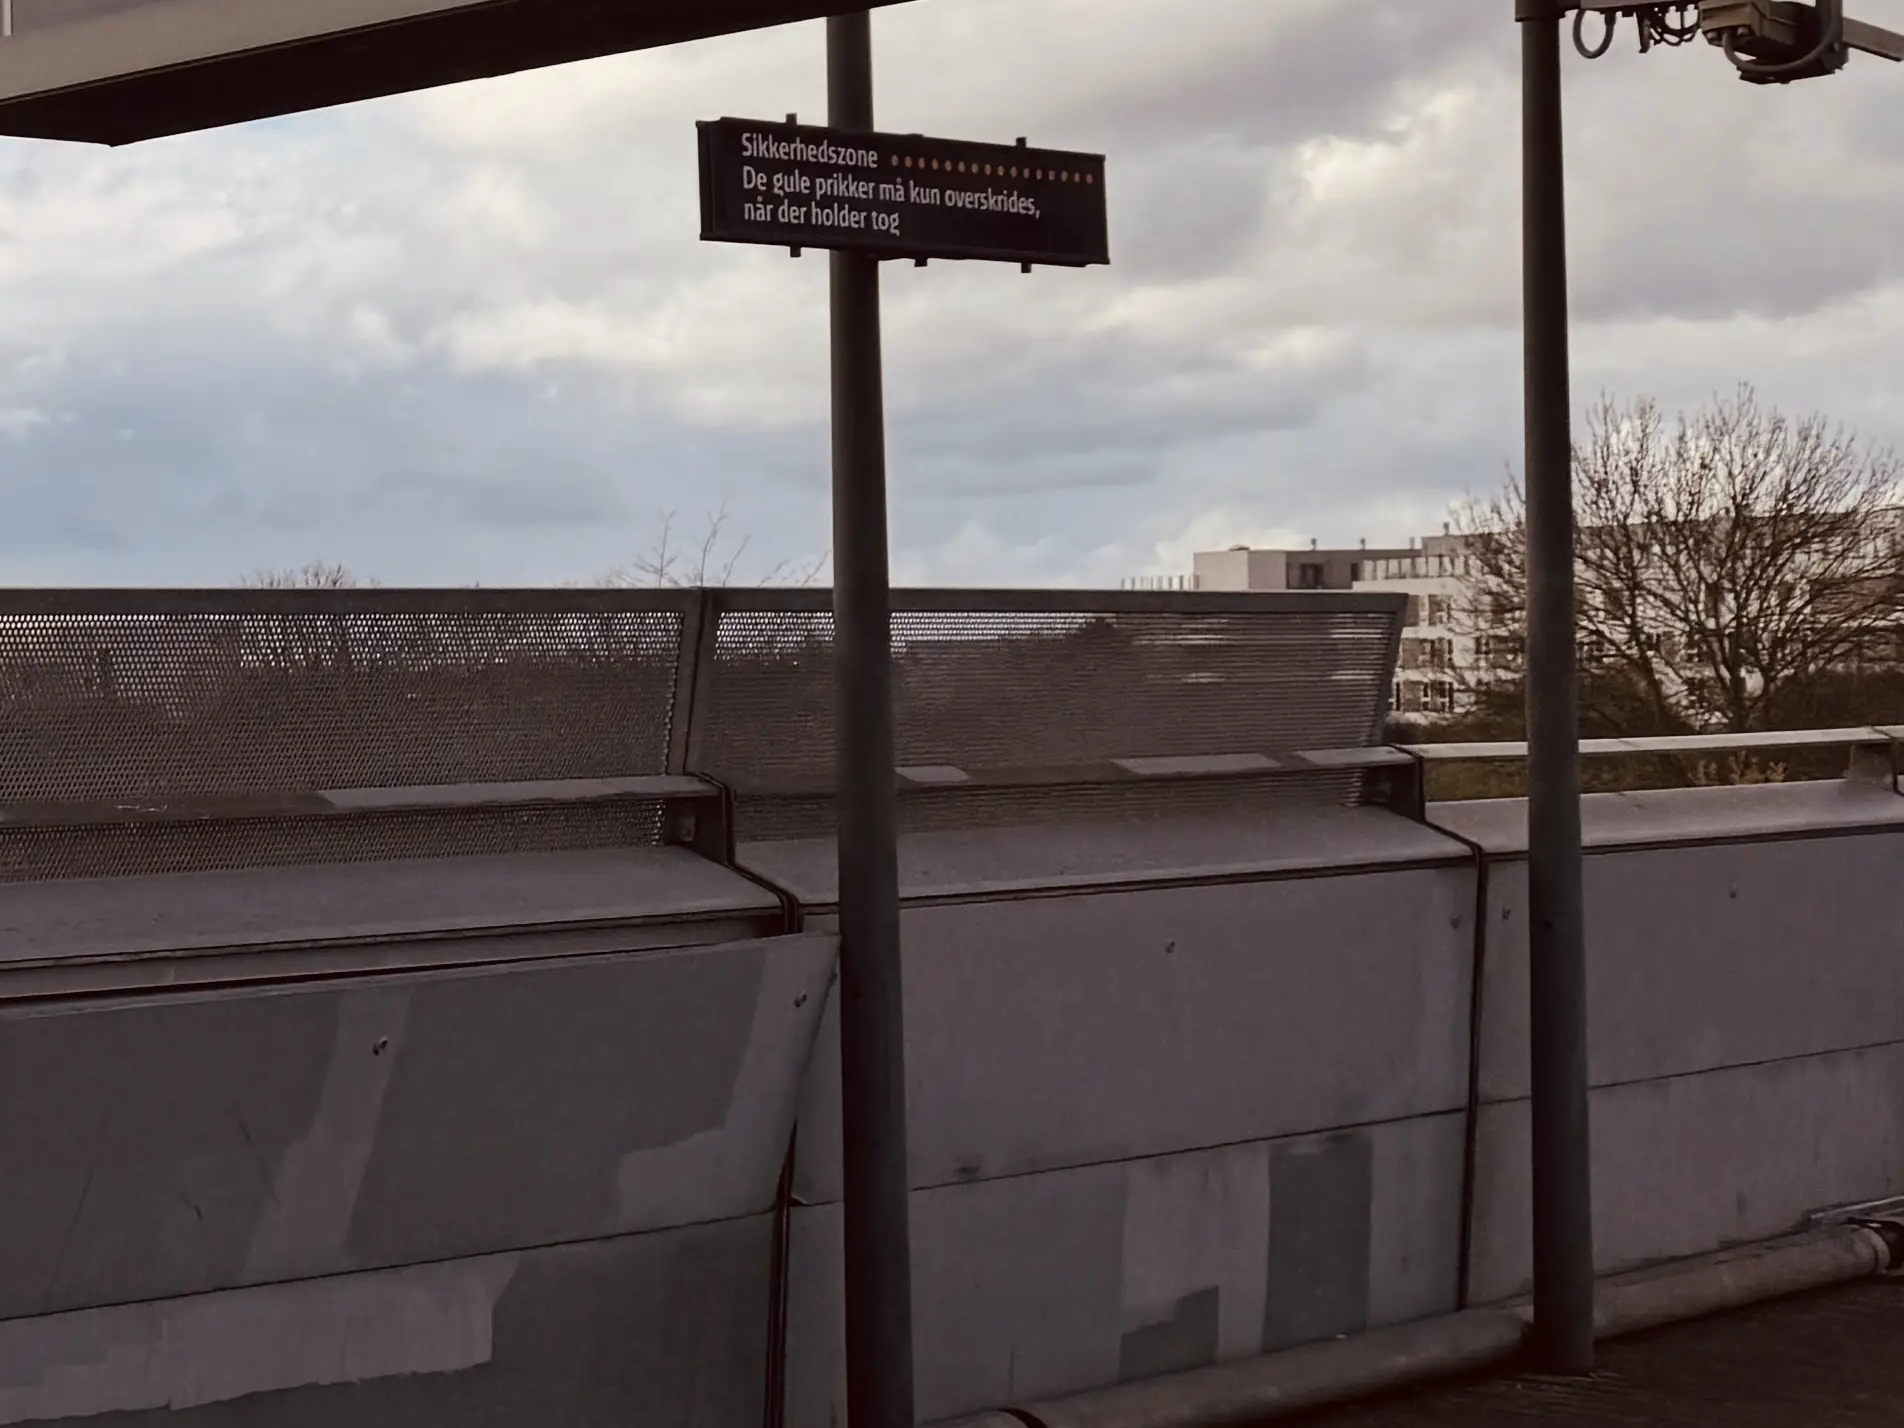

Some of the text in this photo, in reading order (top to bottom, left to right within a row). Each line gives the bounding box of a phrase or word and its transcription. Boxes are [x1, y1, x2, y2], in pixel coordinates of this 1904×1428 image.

[741, 132, 879, 168] Sikkerhedszone
[742, 165, 1041, 219] De gule prikker må kun overskrides,
[744, 195, 901, 236] når der holder tog
